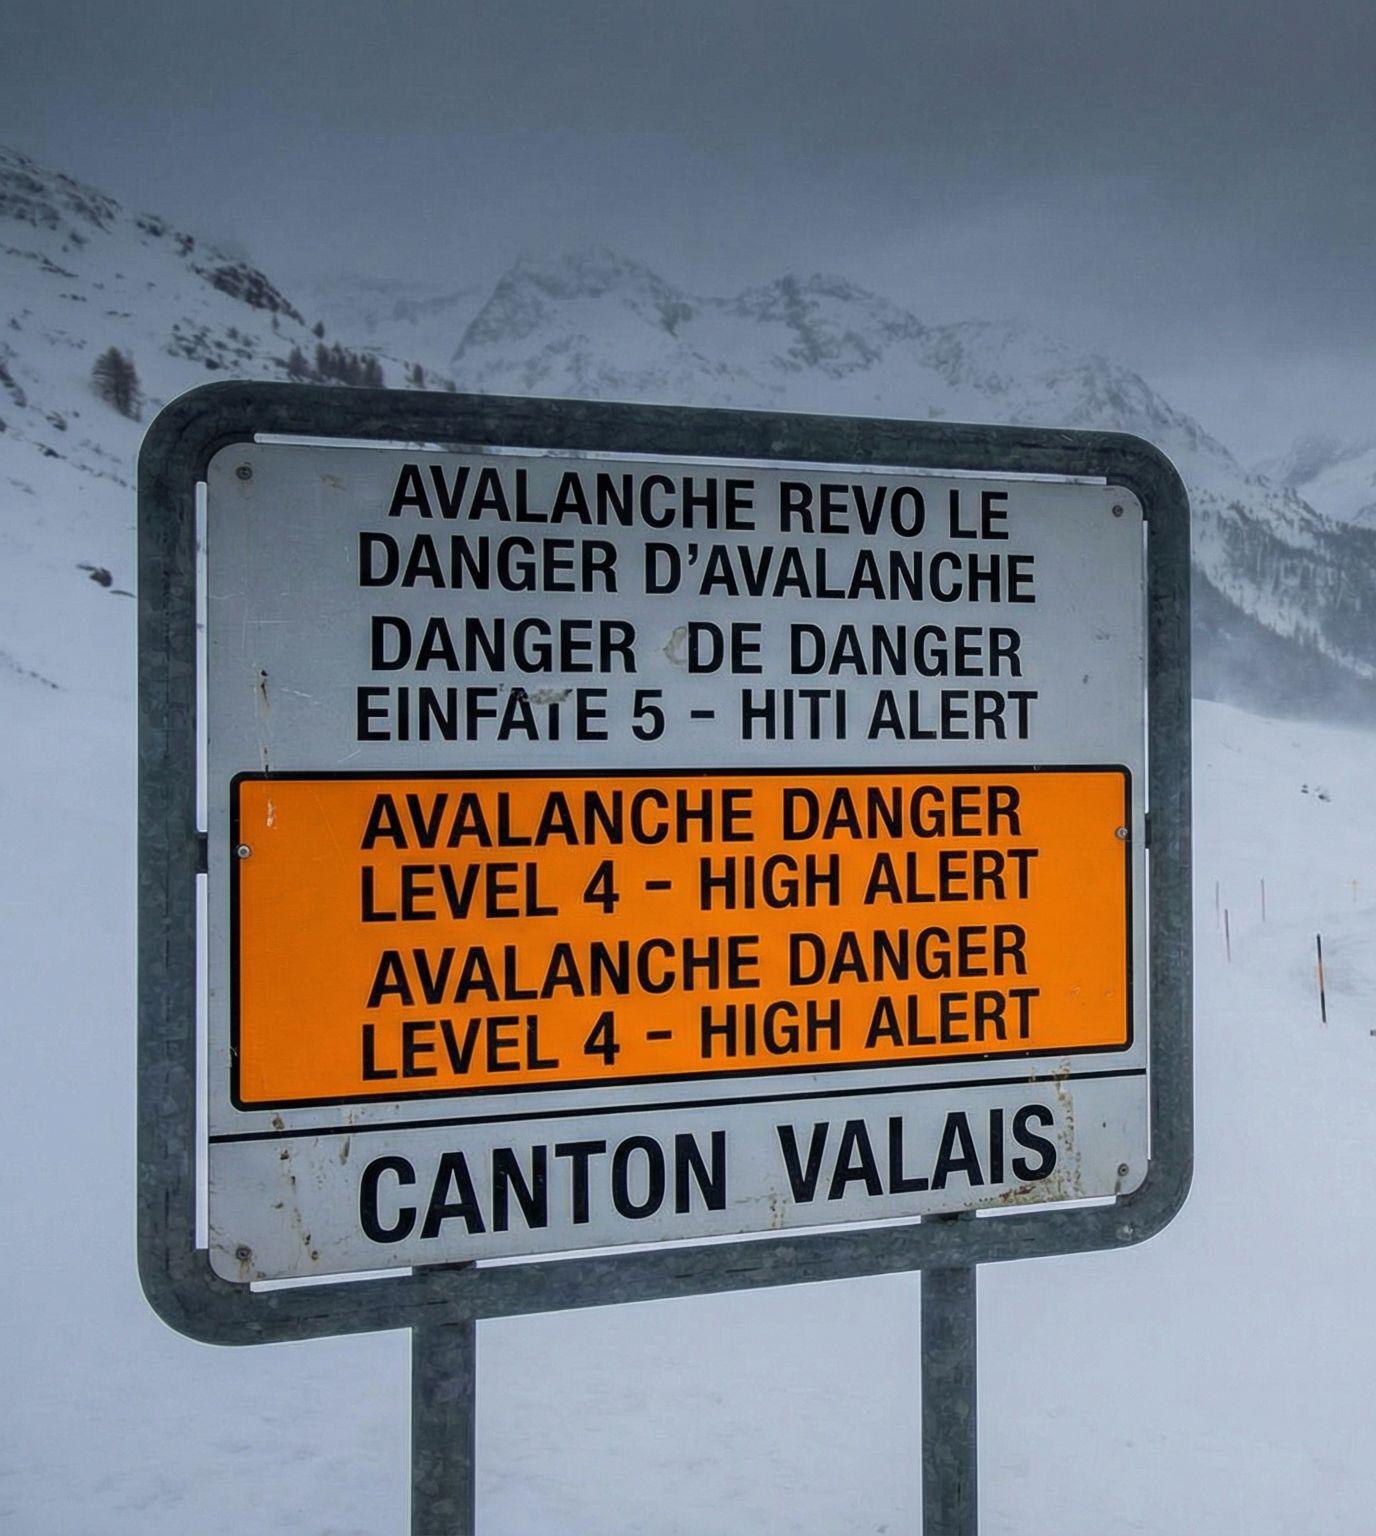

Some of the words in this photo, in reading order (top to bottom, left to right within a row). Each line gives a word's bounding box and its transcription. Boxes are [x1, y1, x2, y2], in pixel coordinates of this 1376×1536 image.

[387, 463, 756, 531] AVALANCHE
[779, 481, 926, 538] REVO
[949, 488, 1009, 540] LE
[359, 531, 618, 593] DANGER
[644, 542, 1036, 604] D'AVALANCHE
[371, 615, 637, 674] DANGER
[687, 621, 763, 674] DE
[790, 623, 1022, 677] DANGER
[631, 689, 665, 741] 5
[741, 688, 846, 740] HITI
[867, 689, 1038, 740] ALERT
[360, 788, 754, 851] AVALANCHE
[783, 785, 1022, 841] DANGER
[361, 862, 559, 923] LEVEL
[583, 859, 620, 914] 4
[700, 853, 840, 911] HIGH
[863, 848, 1039, 905] ALERT
[366, 935, 760, 1009] AVALANCHE
[789, 924, 1027, 986] DANGER
[362, 1014, 560, 1082] LEVEL
[583, 1011, 621, 1066] 4
[700, 999, 841, 1059] HIGH
[864, 988, 1040, 1049] ALERT
[359, 1130, 726, 1244] CANTON
[776, 1104, 1057, 1204] VALAIS
